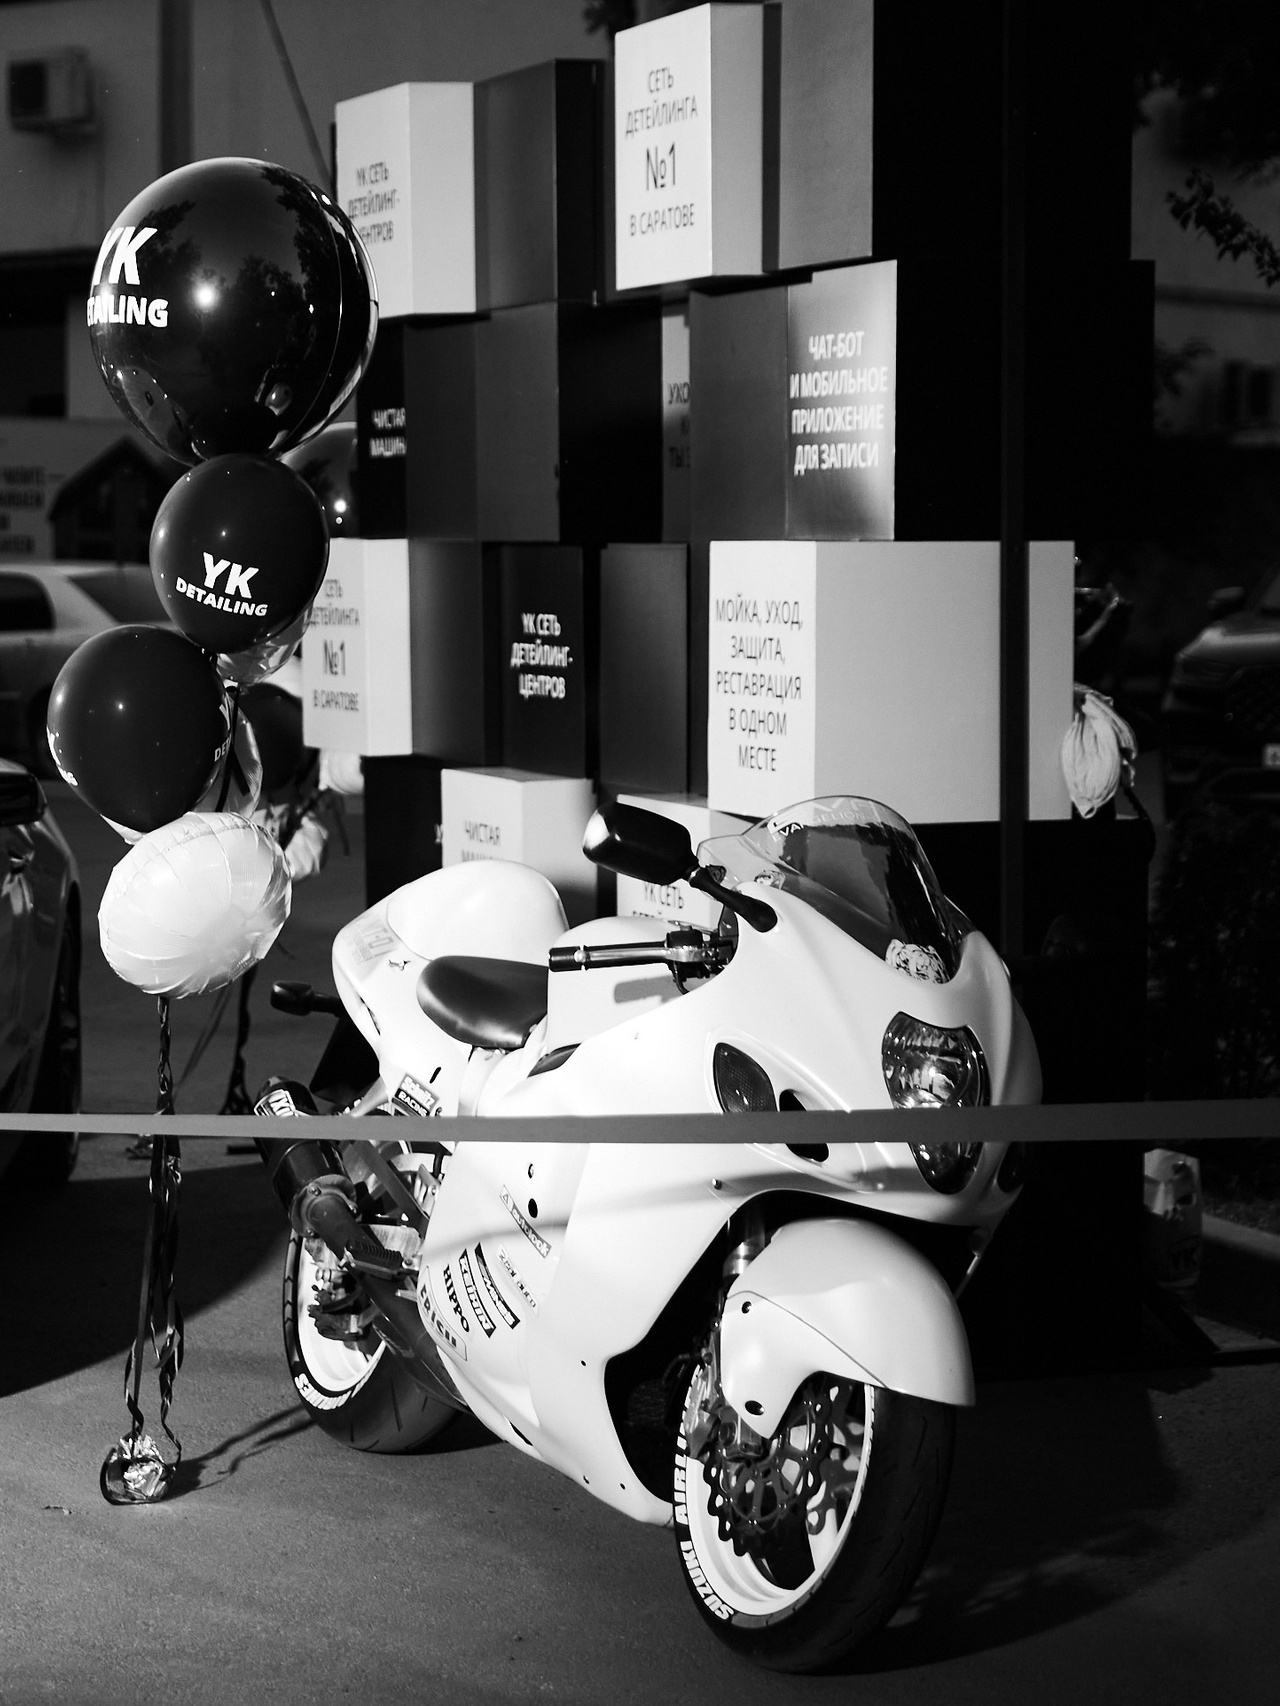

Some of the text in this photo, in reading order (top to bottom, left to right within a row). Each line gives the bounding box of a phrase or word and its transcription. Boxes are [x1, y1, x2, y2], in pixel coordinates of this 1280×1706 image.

[648, 67, 674, 93] СЕТЬ
[625, 95, 698, 139] ДЕТЕЙЛИНГА
[369, 162, 389, 184] СЕТЬ
[646, 142, 676, 191] №1
[358, 220, 395, 245] ЕНТРОВ
[630, 203, 695, 237] В САРАТОВЕ
[93, 226, 158, 286] YK
[87, 294, 169, 328] ETAILING
[808, 331, 865, 361] ЧАТ-БОТ
[668, 382, 691, 404] УХО
[790, 366, 888, 399] И МОБИЛЬНОЕ
[792, 404, 885, 434] ПРИЛОЖЕНИЕ
[794, 442, 879, 476] ДЛЯ ЗАПИСИ
[203, 552, 259, 599] YK
[176, 576, 268, 616] DETAILING
[716, 593, 804, 631] МОЙКА, УХОД,
[536, 613, 561, 637] СЕТЬ
[323, 639, 346, 675] №1
[730, 635, 786, 666] ЗАЩИТА,
[519, 673, 566, 700] ЦЕНТРОВ
[716, 670, 802, 704] РЕСТАВРАЦИЯ
[729, 707, 787, 739] В ОДНОМ
[738, 744, 777, 773] МЕСТЕ
[464, 820, 501, 847] ЧИСТАЯ
[659, 884, 685, 910] СЕТЬ
[443, 1264, 470, 1333] HIPPO
[680, 1540, 734, 1620] SUZUKI
